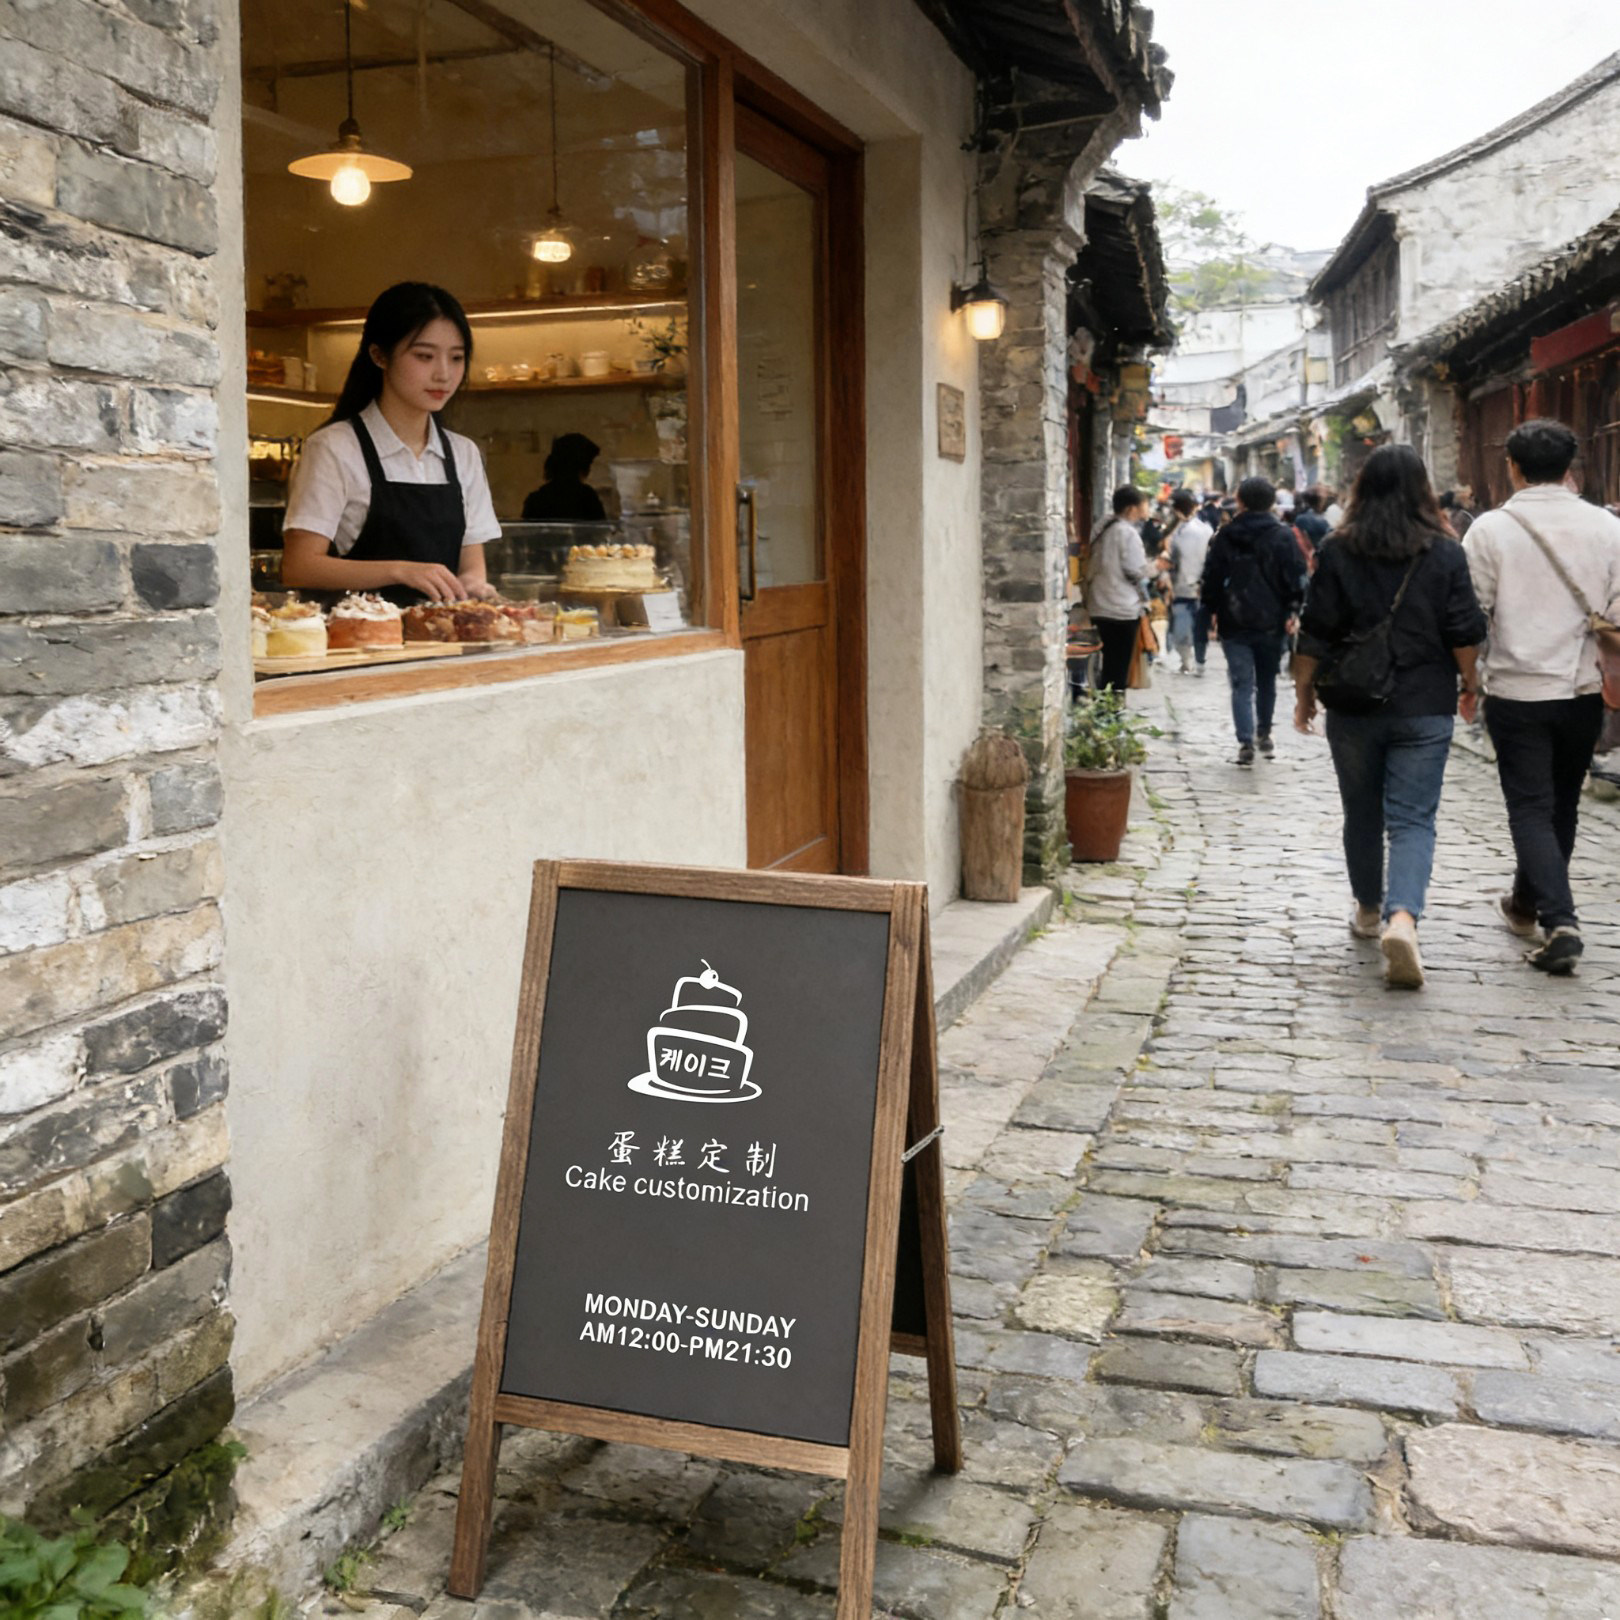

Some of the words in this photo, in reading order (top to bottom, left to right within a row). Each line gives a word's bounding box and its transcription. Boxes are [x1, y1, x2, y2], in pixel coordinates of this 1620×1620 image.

[659, 1046, 731, 1079] 케이크
[607, 1130, 778, 1179] 蛋糕定制
[565, 1164, 627, 1193] Cake
[633, 1177, 809, 1212] customization
[584, 1292, 797, 1339] MONDAY-SUNDAY
[579, 1320, 792, 1369] AM12:00-PM21:30
